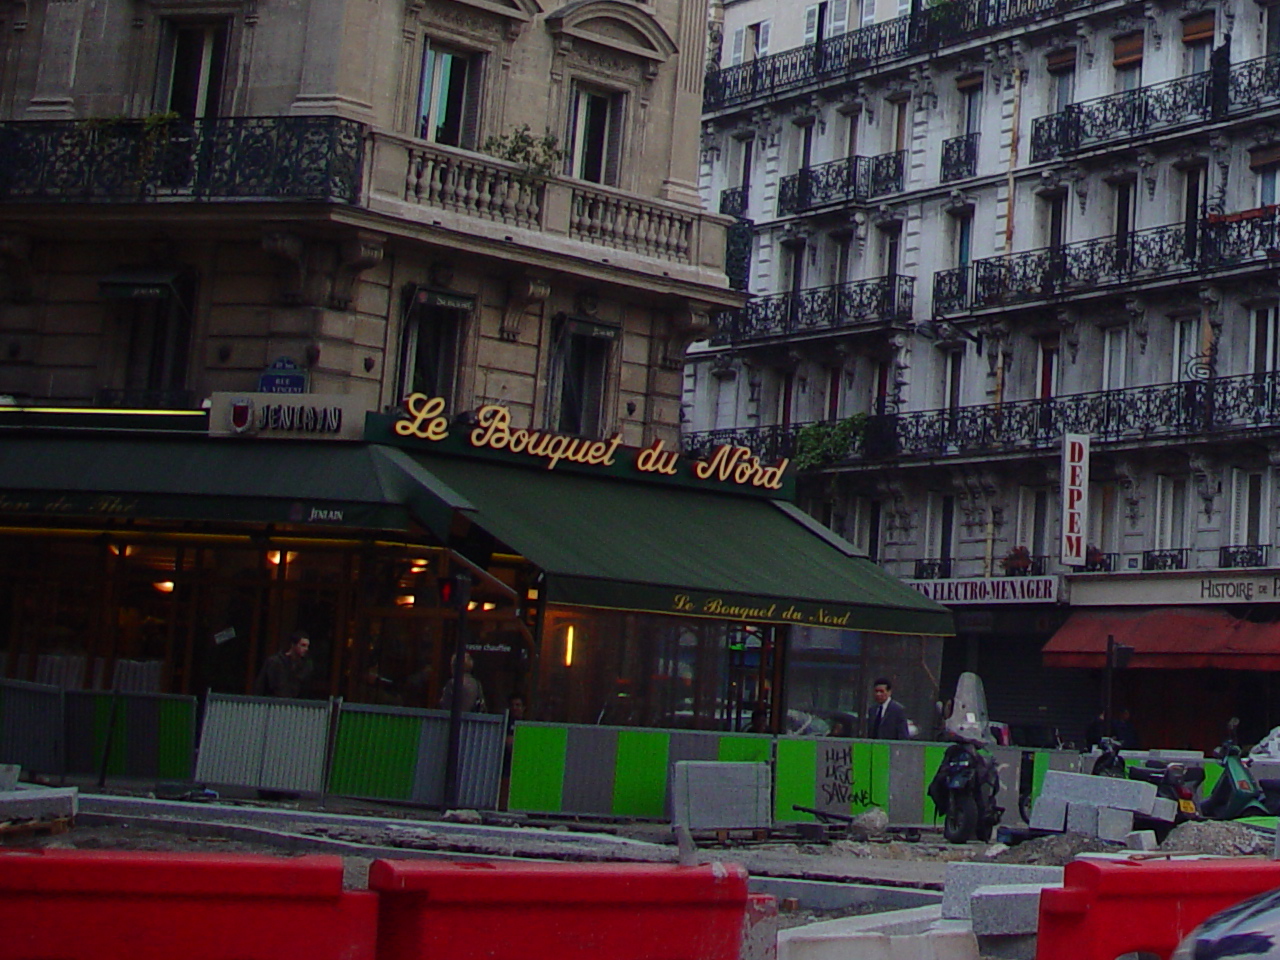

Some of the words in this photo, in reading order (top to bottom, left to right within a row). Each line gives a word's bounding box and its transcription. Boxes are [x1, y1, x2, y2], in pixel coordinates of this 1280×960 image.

[257, 404, 342, 432] JENLAIN
[396, 393, 449, 441] Le
[471, 405, 622, 471] Bouquet
[637, 439, 680, 475] du
[696, 445, 790, 490] Nord
[1064, 440, 1086, 558] DEPEM
[1201, 579, 1253, 600] HISTOIRE
[675, 594, 694, 611] Le
[704, 598, 776, 618] Bouquet
[782, 606, 802, 619] du
[809, 608, 850, 625] Nord
